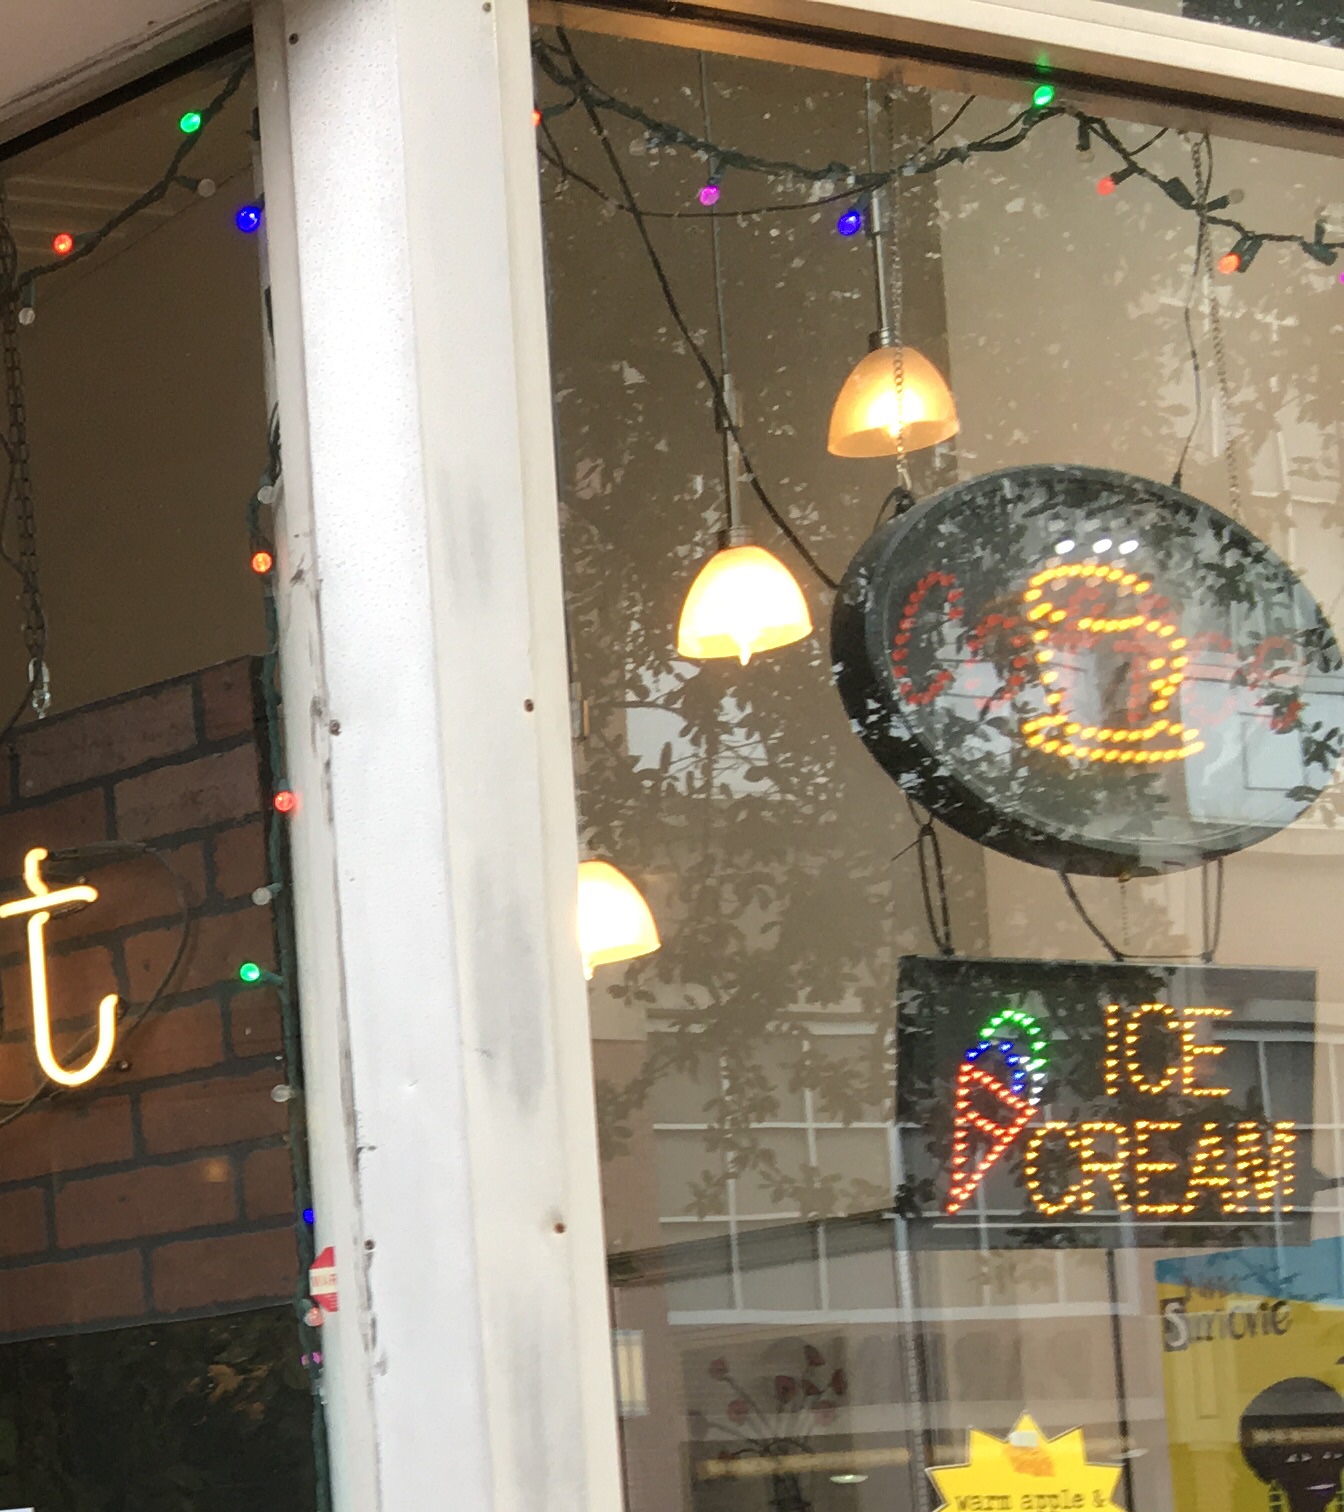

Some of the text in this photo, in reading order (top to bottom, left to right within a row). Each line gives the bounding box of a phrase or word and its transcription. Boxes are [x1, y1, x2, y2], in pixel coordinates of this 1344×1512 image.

[1104, 1003, 1234, 1096] ICE
[1023, 1120, 1297, 1216] CREAM
[954, 1493, 1013, 1512] warm
